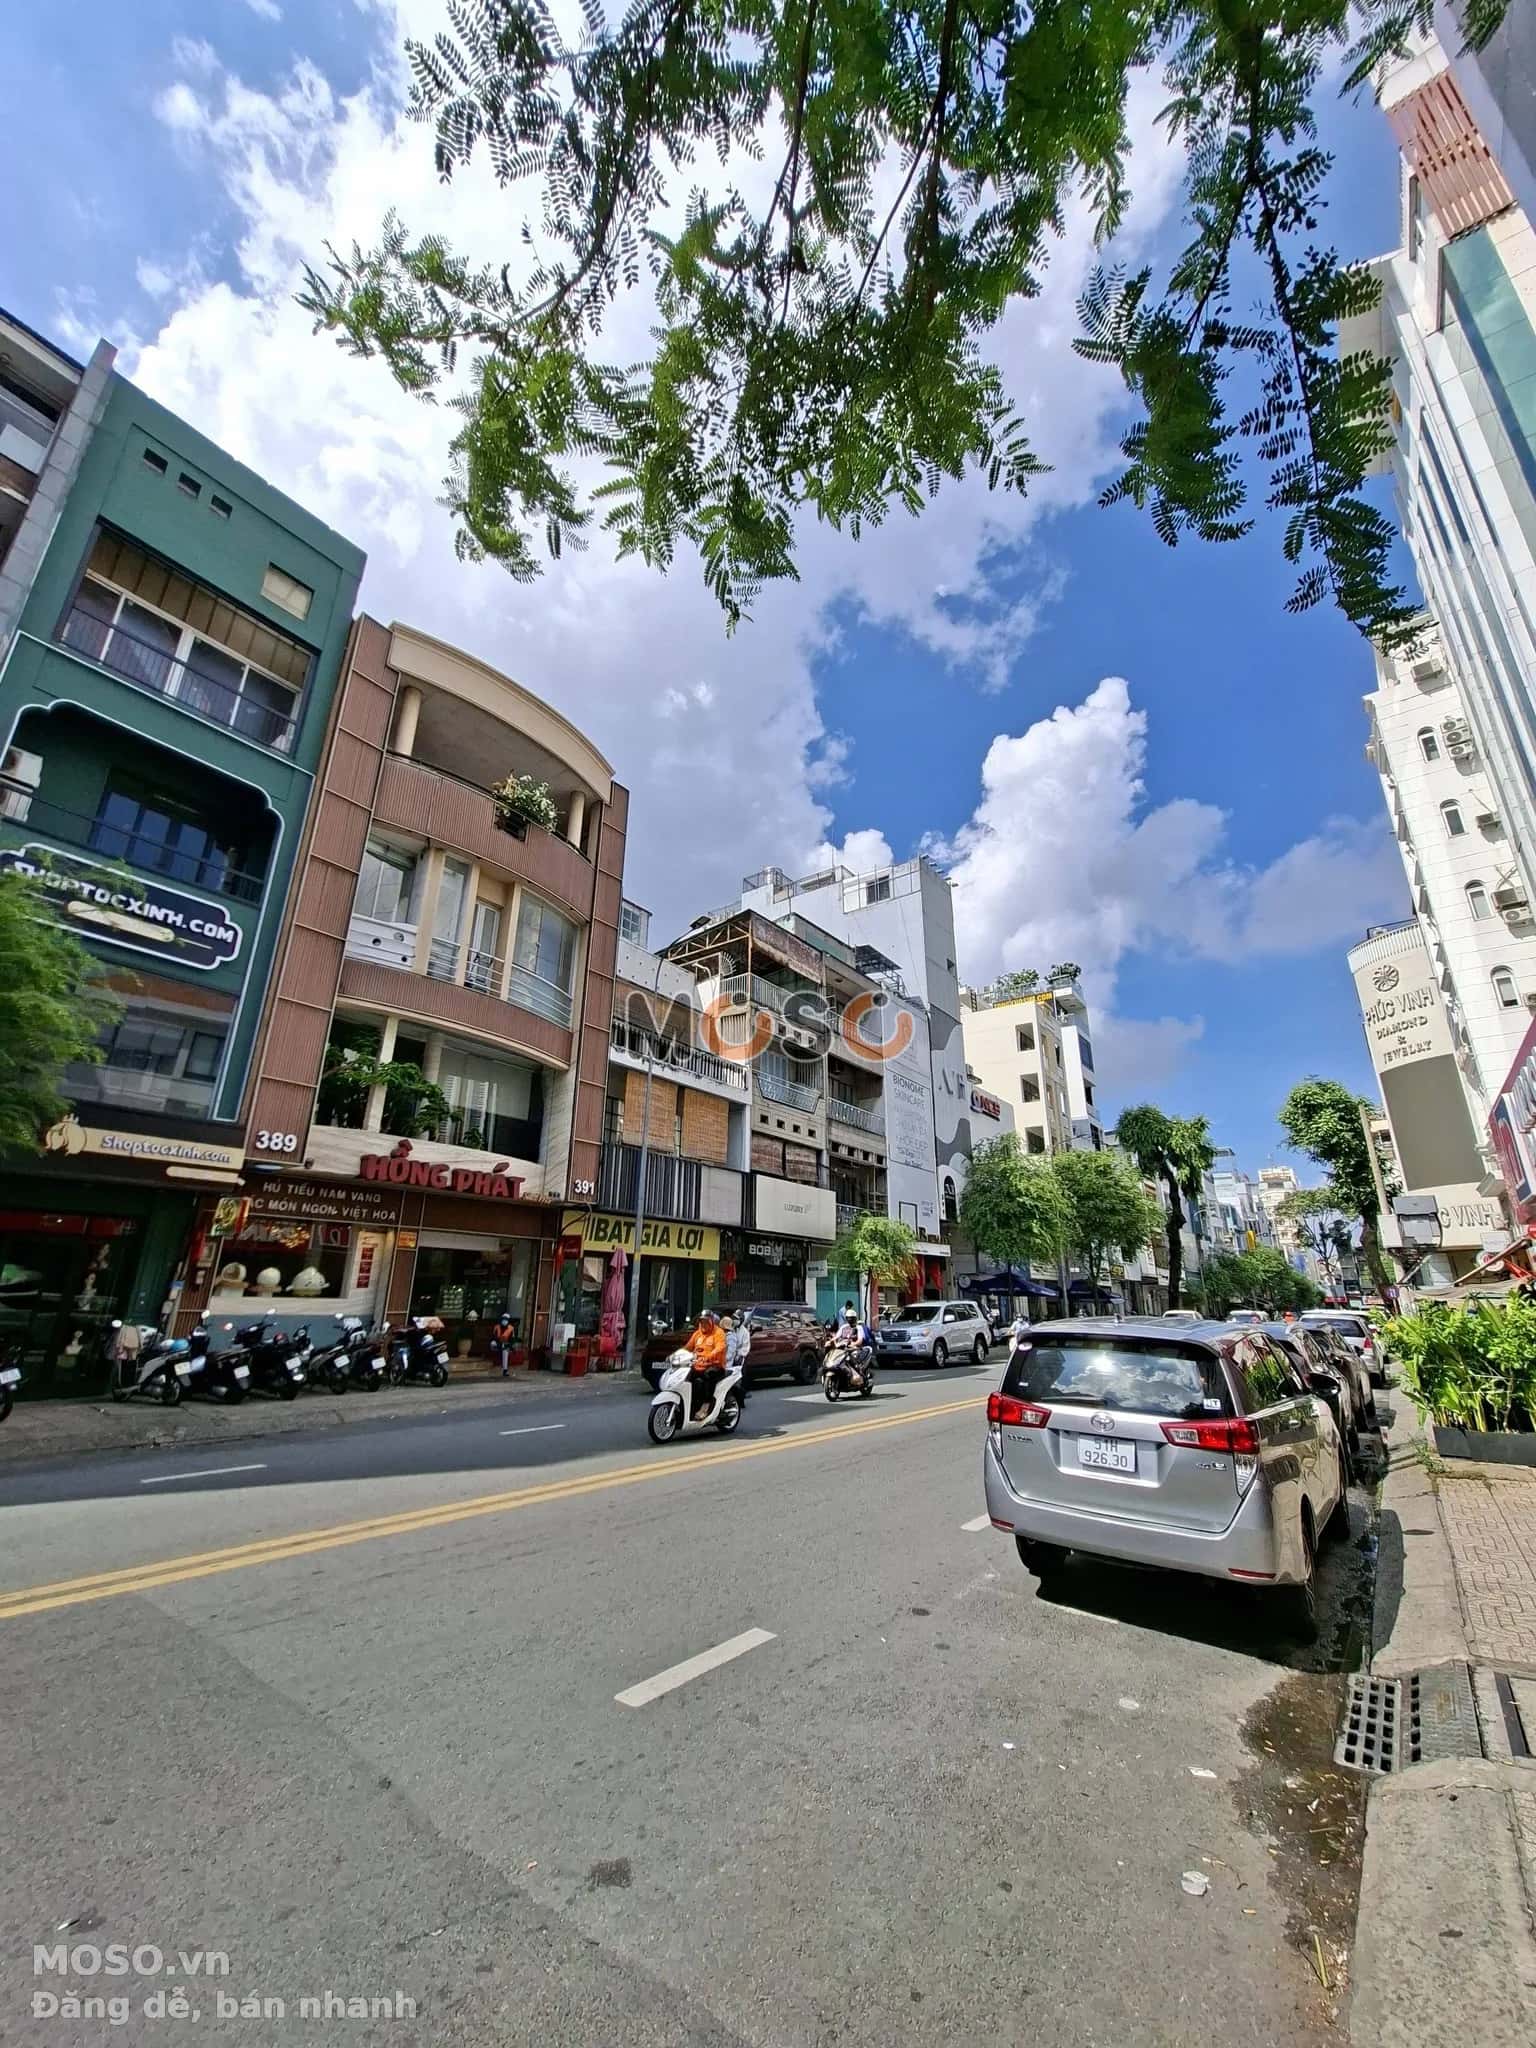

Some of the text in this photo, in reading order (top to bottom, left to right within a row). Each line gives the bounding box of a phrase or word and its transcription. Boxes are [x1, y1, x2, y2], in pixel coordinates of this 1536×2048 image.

[1365, 986, 1434, 1027] PHÚC VINH
[1376, 1015, 1428, 1040] DIAMOND
[1383, 1040, 1432, 1064] JEWELRY
[255, 1130, 297, 1153] 389
[451, 1161, 526, 1201] PHÁT
[574, 1178, 595, 1195] 391
[319, 1187, 346, 1200] NAM
[351, 1191, 381, 1203] VANG
[372, 1209, 396, 1222] HOA
[1450, 1203, 1497, 1228] VINH
[640, 1223, 671, 1248] GIA
[1084, 1450, 1128, 1468] 926.30
